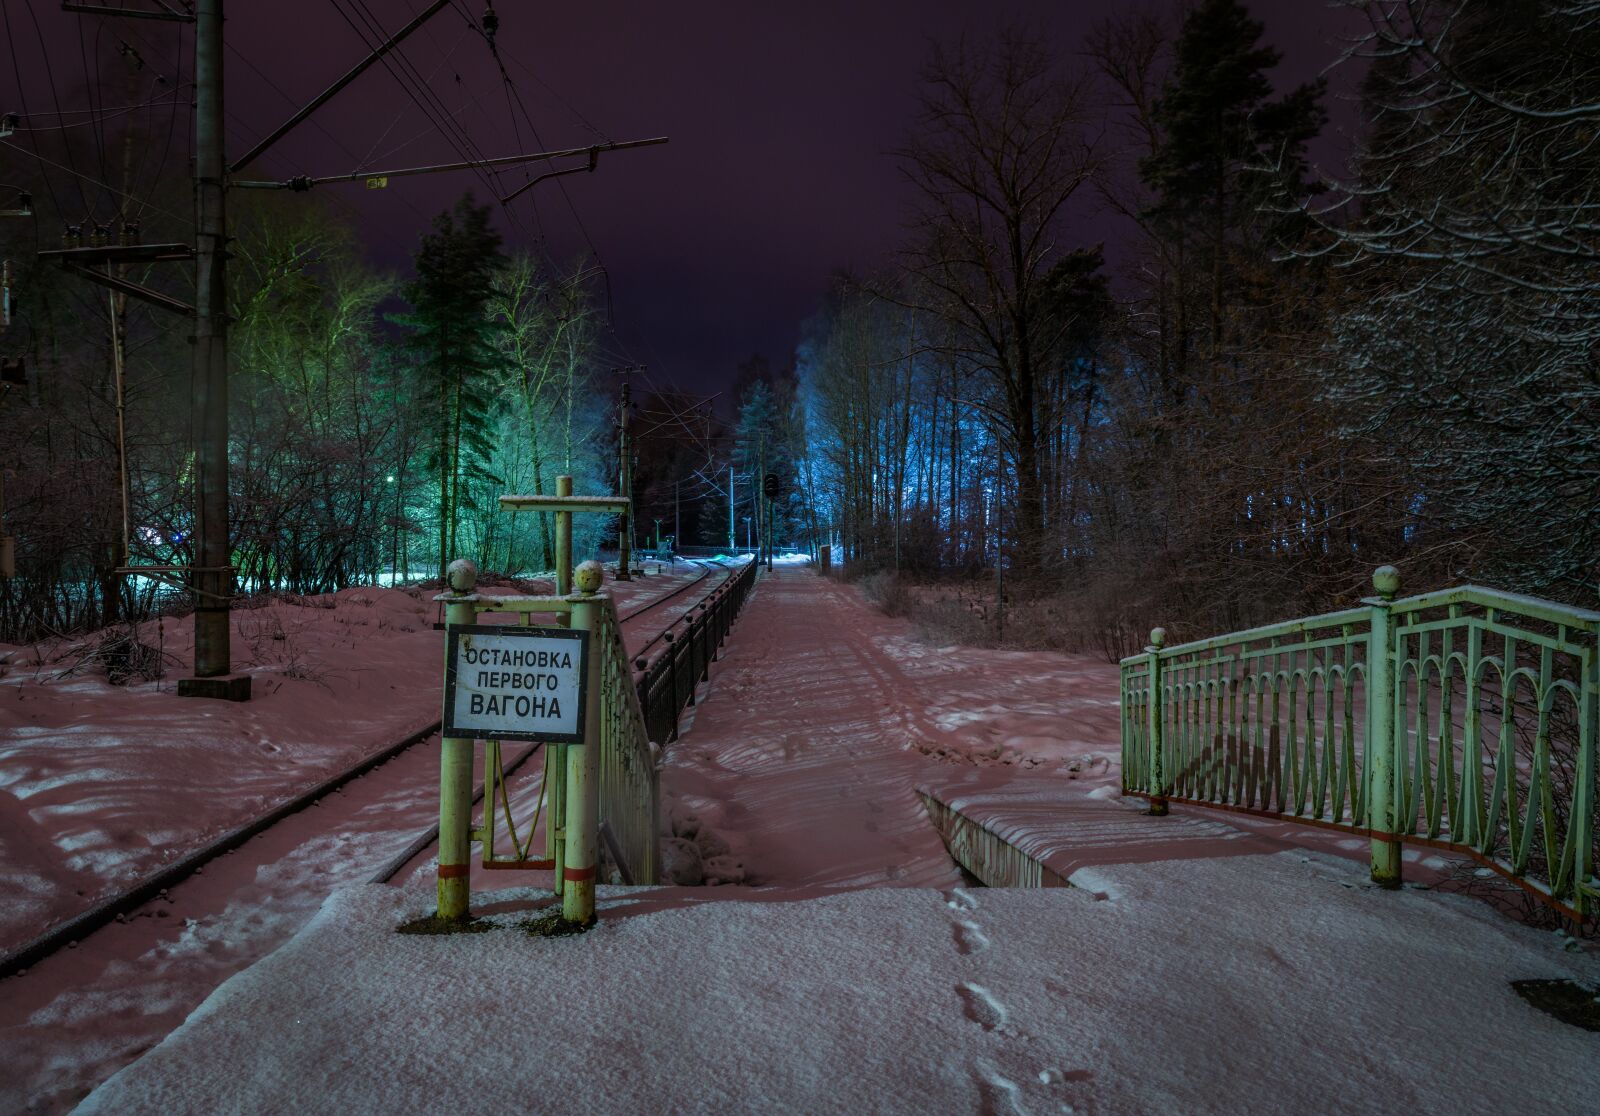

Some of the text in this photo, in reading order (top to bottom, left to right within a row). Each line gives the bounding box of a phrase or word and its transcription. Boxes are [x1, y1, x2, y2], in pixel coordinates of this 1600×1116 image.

[466, 649, 571, 668] ОСТАНОВКА
[478, 671, 558, 690] ПЕРВОГО
[470, 693, 561, 718] ВАГОНА
